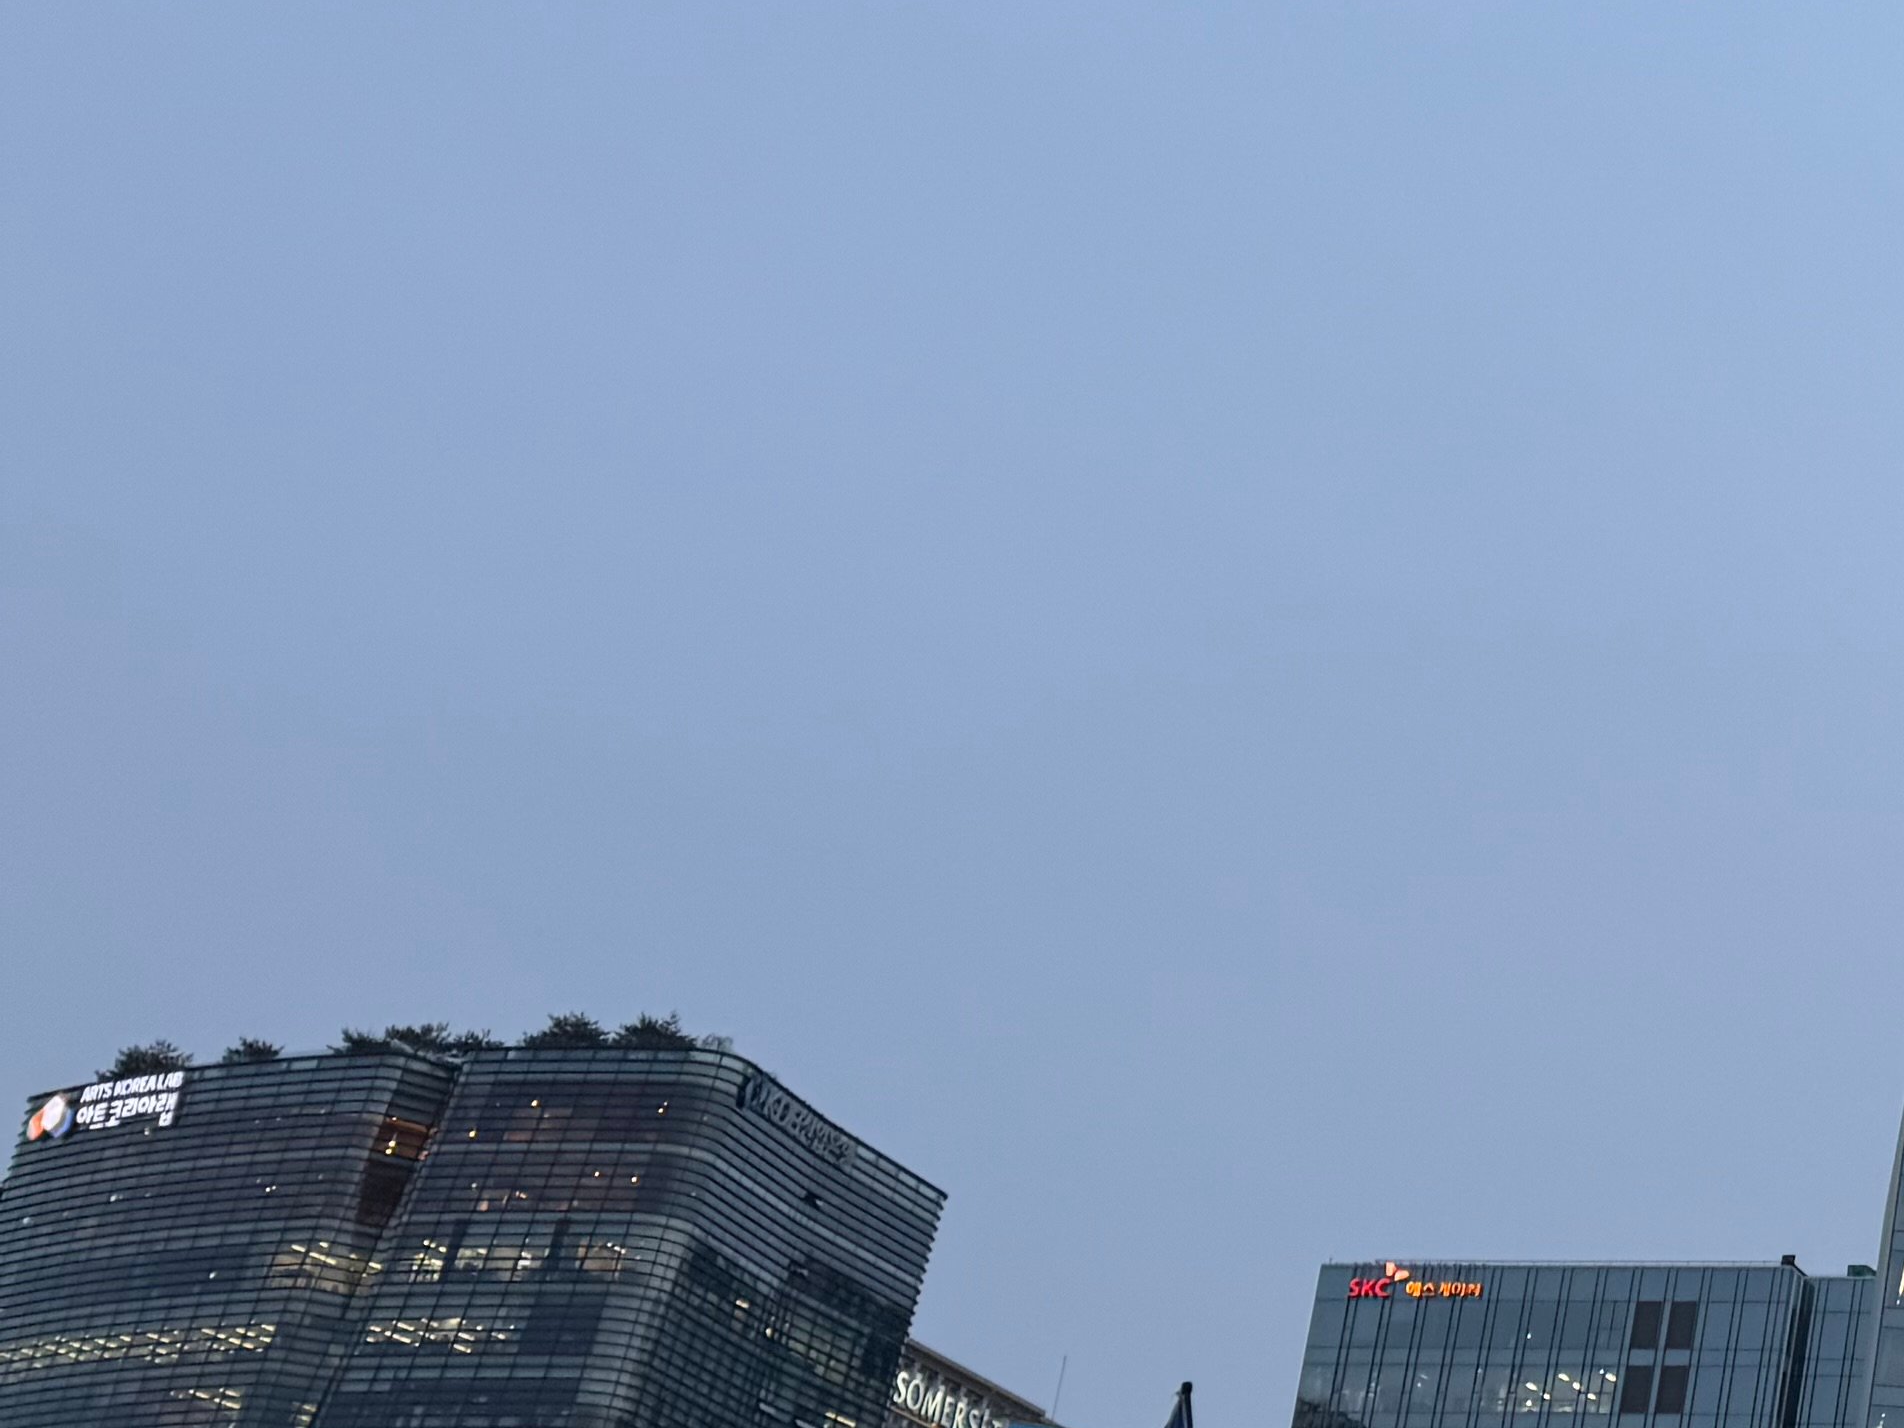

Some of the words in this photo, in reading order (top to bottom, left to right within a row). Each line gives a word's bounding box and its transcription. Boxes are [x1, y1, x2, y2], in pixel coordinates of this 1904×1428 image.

[80, 1082, 113, 1103] ARTS
[76, 1092, 179, 1129] 아트코리아랩
[1349, 1277, 1391, 1297] SKC
